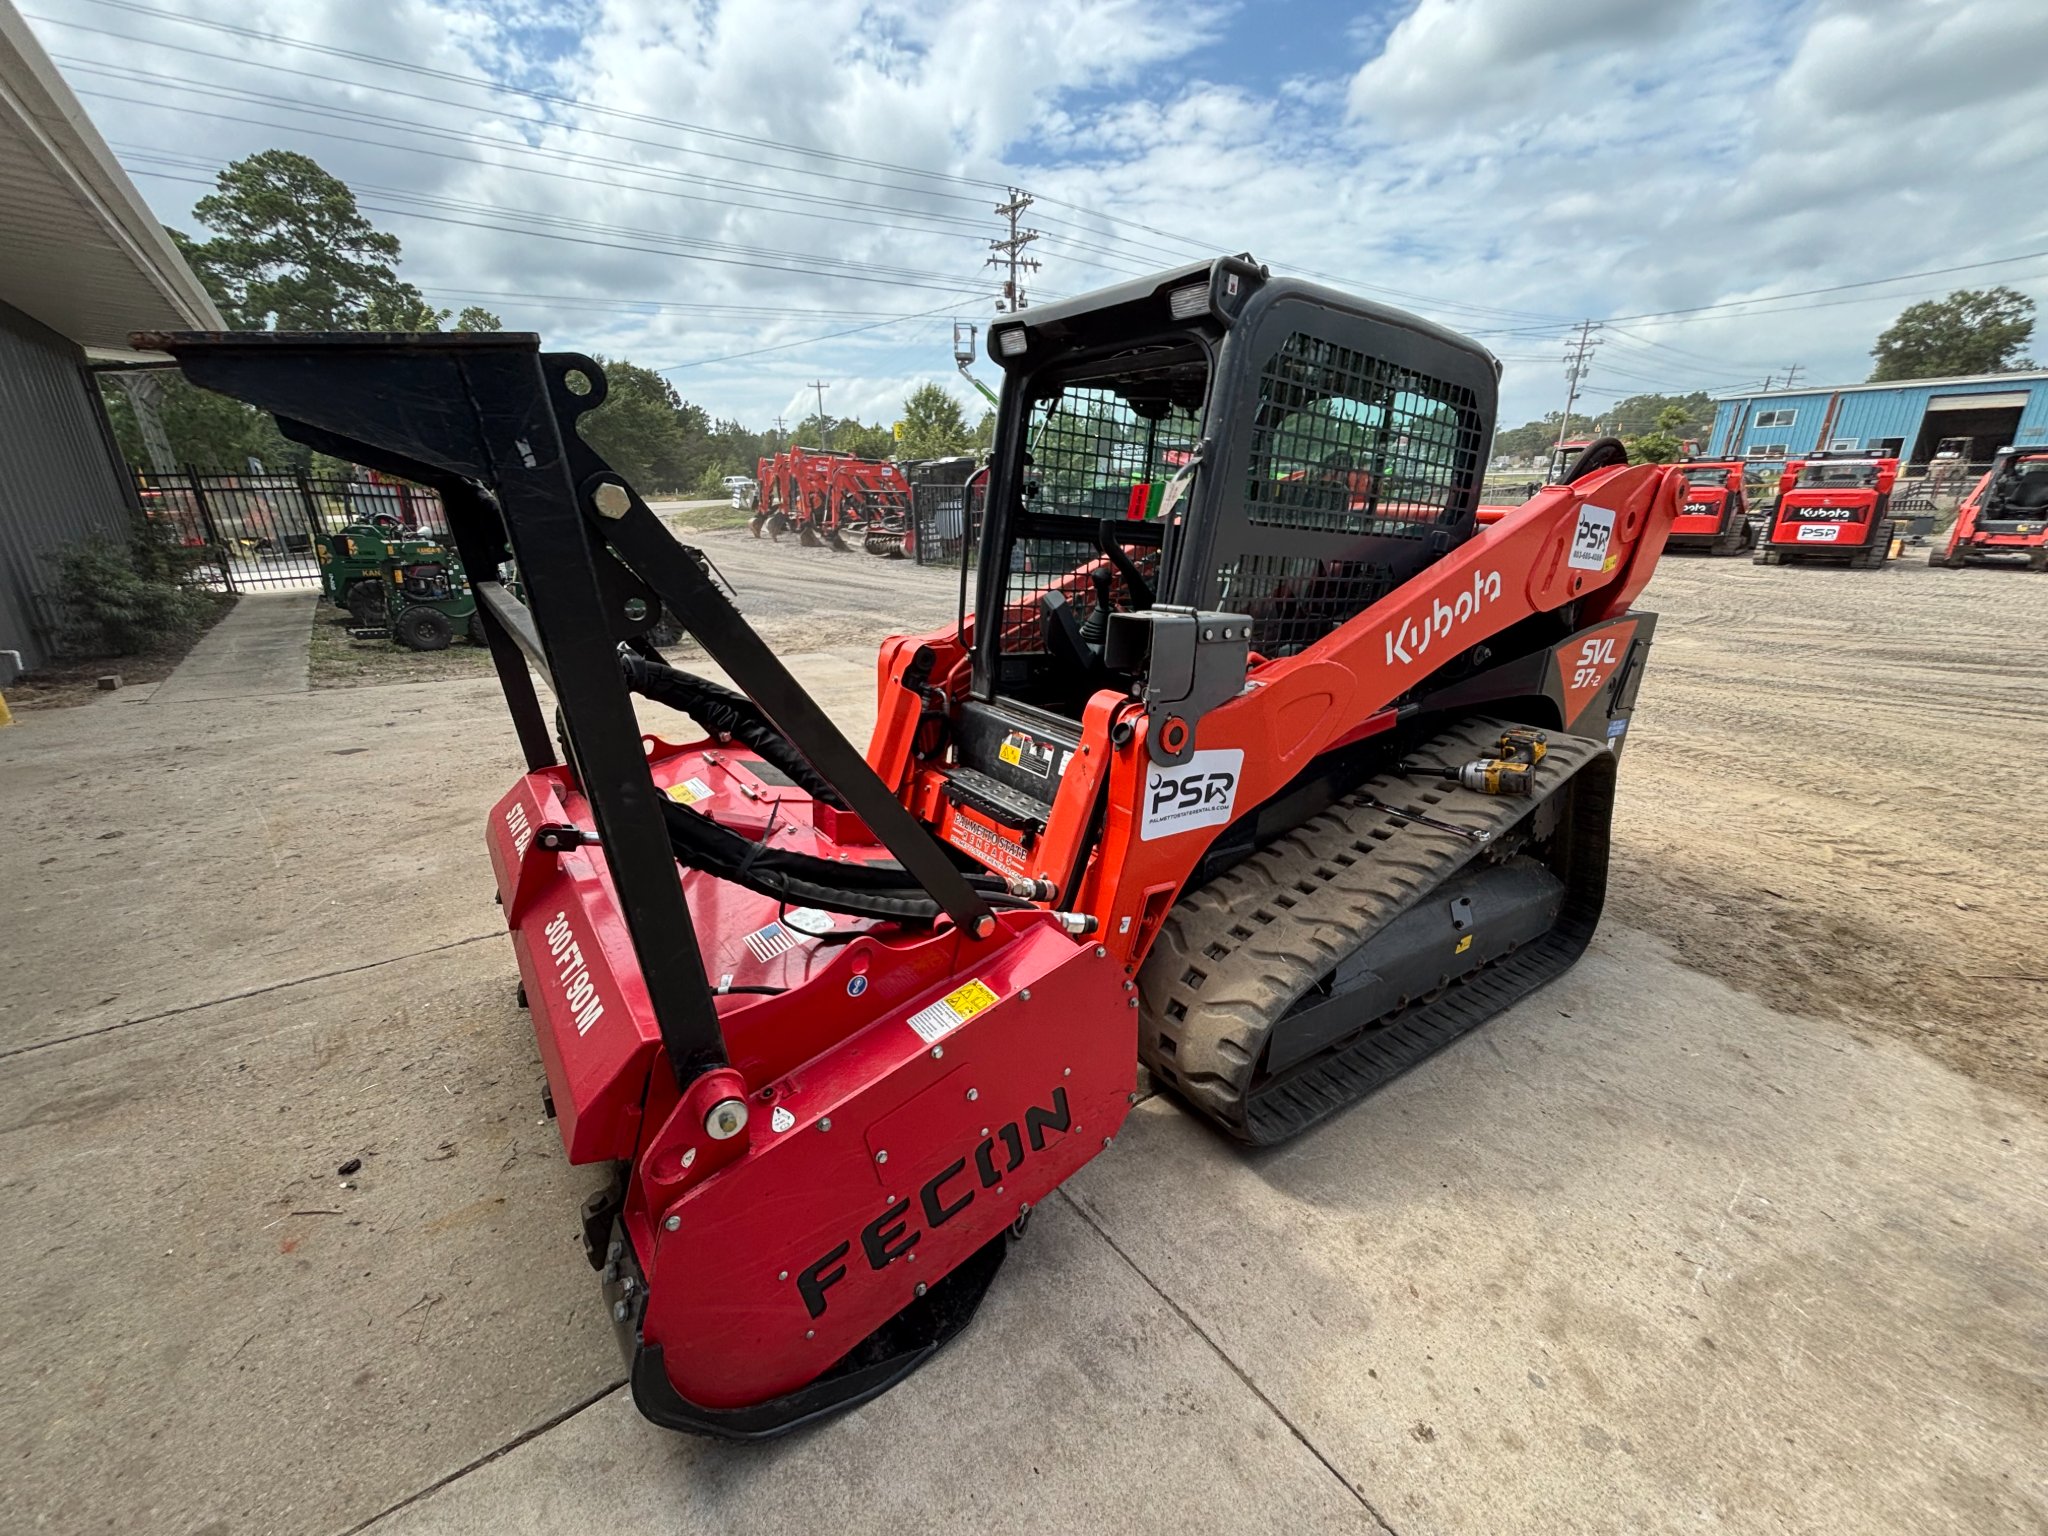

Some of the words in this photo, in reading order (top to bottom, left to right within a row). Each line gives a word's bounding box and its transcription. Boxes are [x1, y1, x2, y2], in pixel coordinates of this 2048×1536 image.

[1799, 507, 1850, 518] Kubota
[1576, 521, 1611, 552] PSR
[1801, 526, 1837, 540] PSR
[1385, 569, 1501, 666] Kubota
[1576, 638, 1616, 666] SVL
[1571, 668, 1602, 689] 97-2
[1150, 772, 1235, 815] PSR
[505, 802, 529, 838] STAY
[1149, 804, 1230, 825] PALMETTOSTATERENTALS.COM
[514, 826, 532, 862] BA
[953, 811, 999, 845] PALMETTO
[997, 836, 1029, 863] STATE
[961, 830, 1013, 866] RENTALS
[796, 1086, 1072, 1320] FECON
